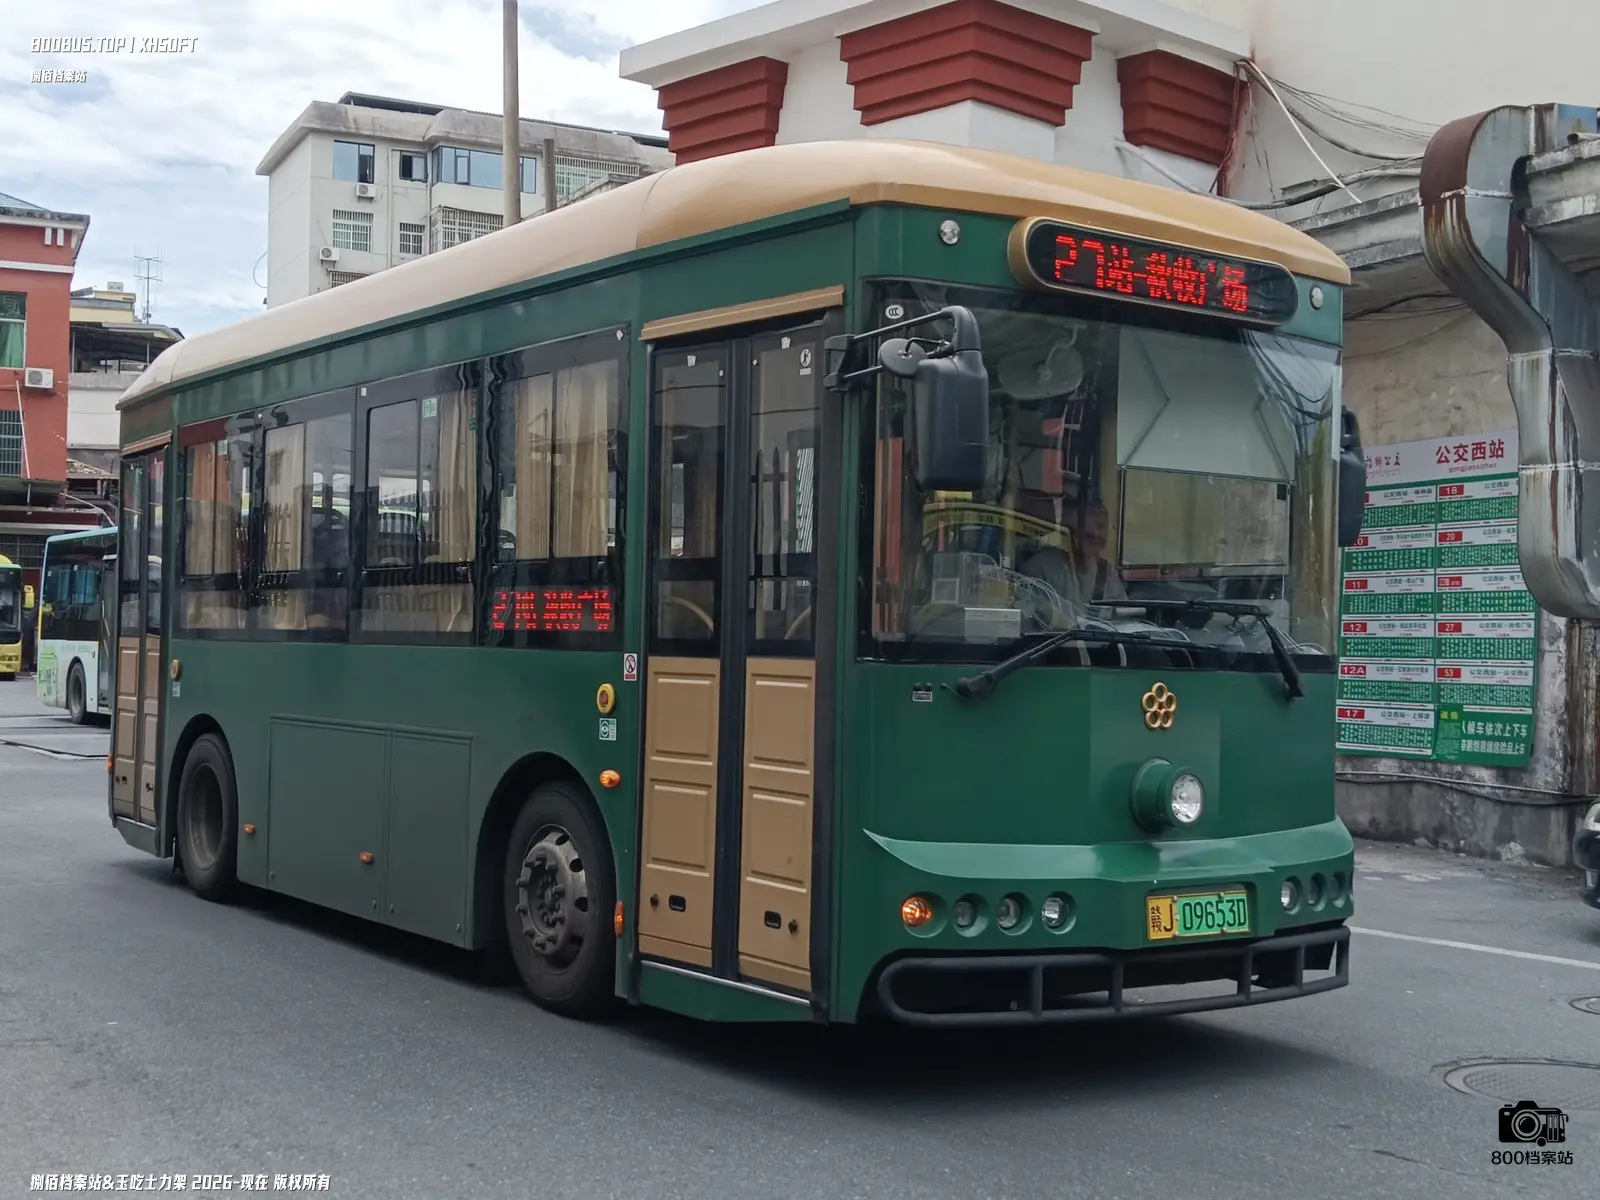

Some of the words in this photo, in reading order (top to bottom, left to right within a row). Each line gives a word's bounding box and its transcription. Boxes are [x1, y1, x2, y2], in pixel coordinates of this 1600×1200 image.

[1435, 438, 1505, 465] 公交西站
[1445, 486, 1458, 495] 18
[1445, 532, 1456, 541] 20
[1351, 581, 1361, 589] 11
[1445, 623, 1455, 632] 27
[1343, 666, 1365, 674] 12A
[1444, 669, 1454, 677] 53
[1345, 709, 1359, 717] 17
[1182, 898, 1248, 931] 09653D
